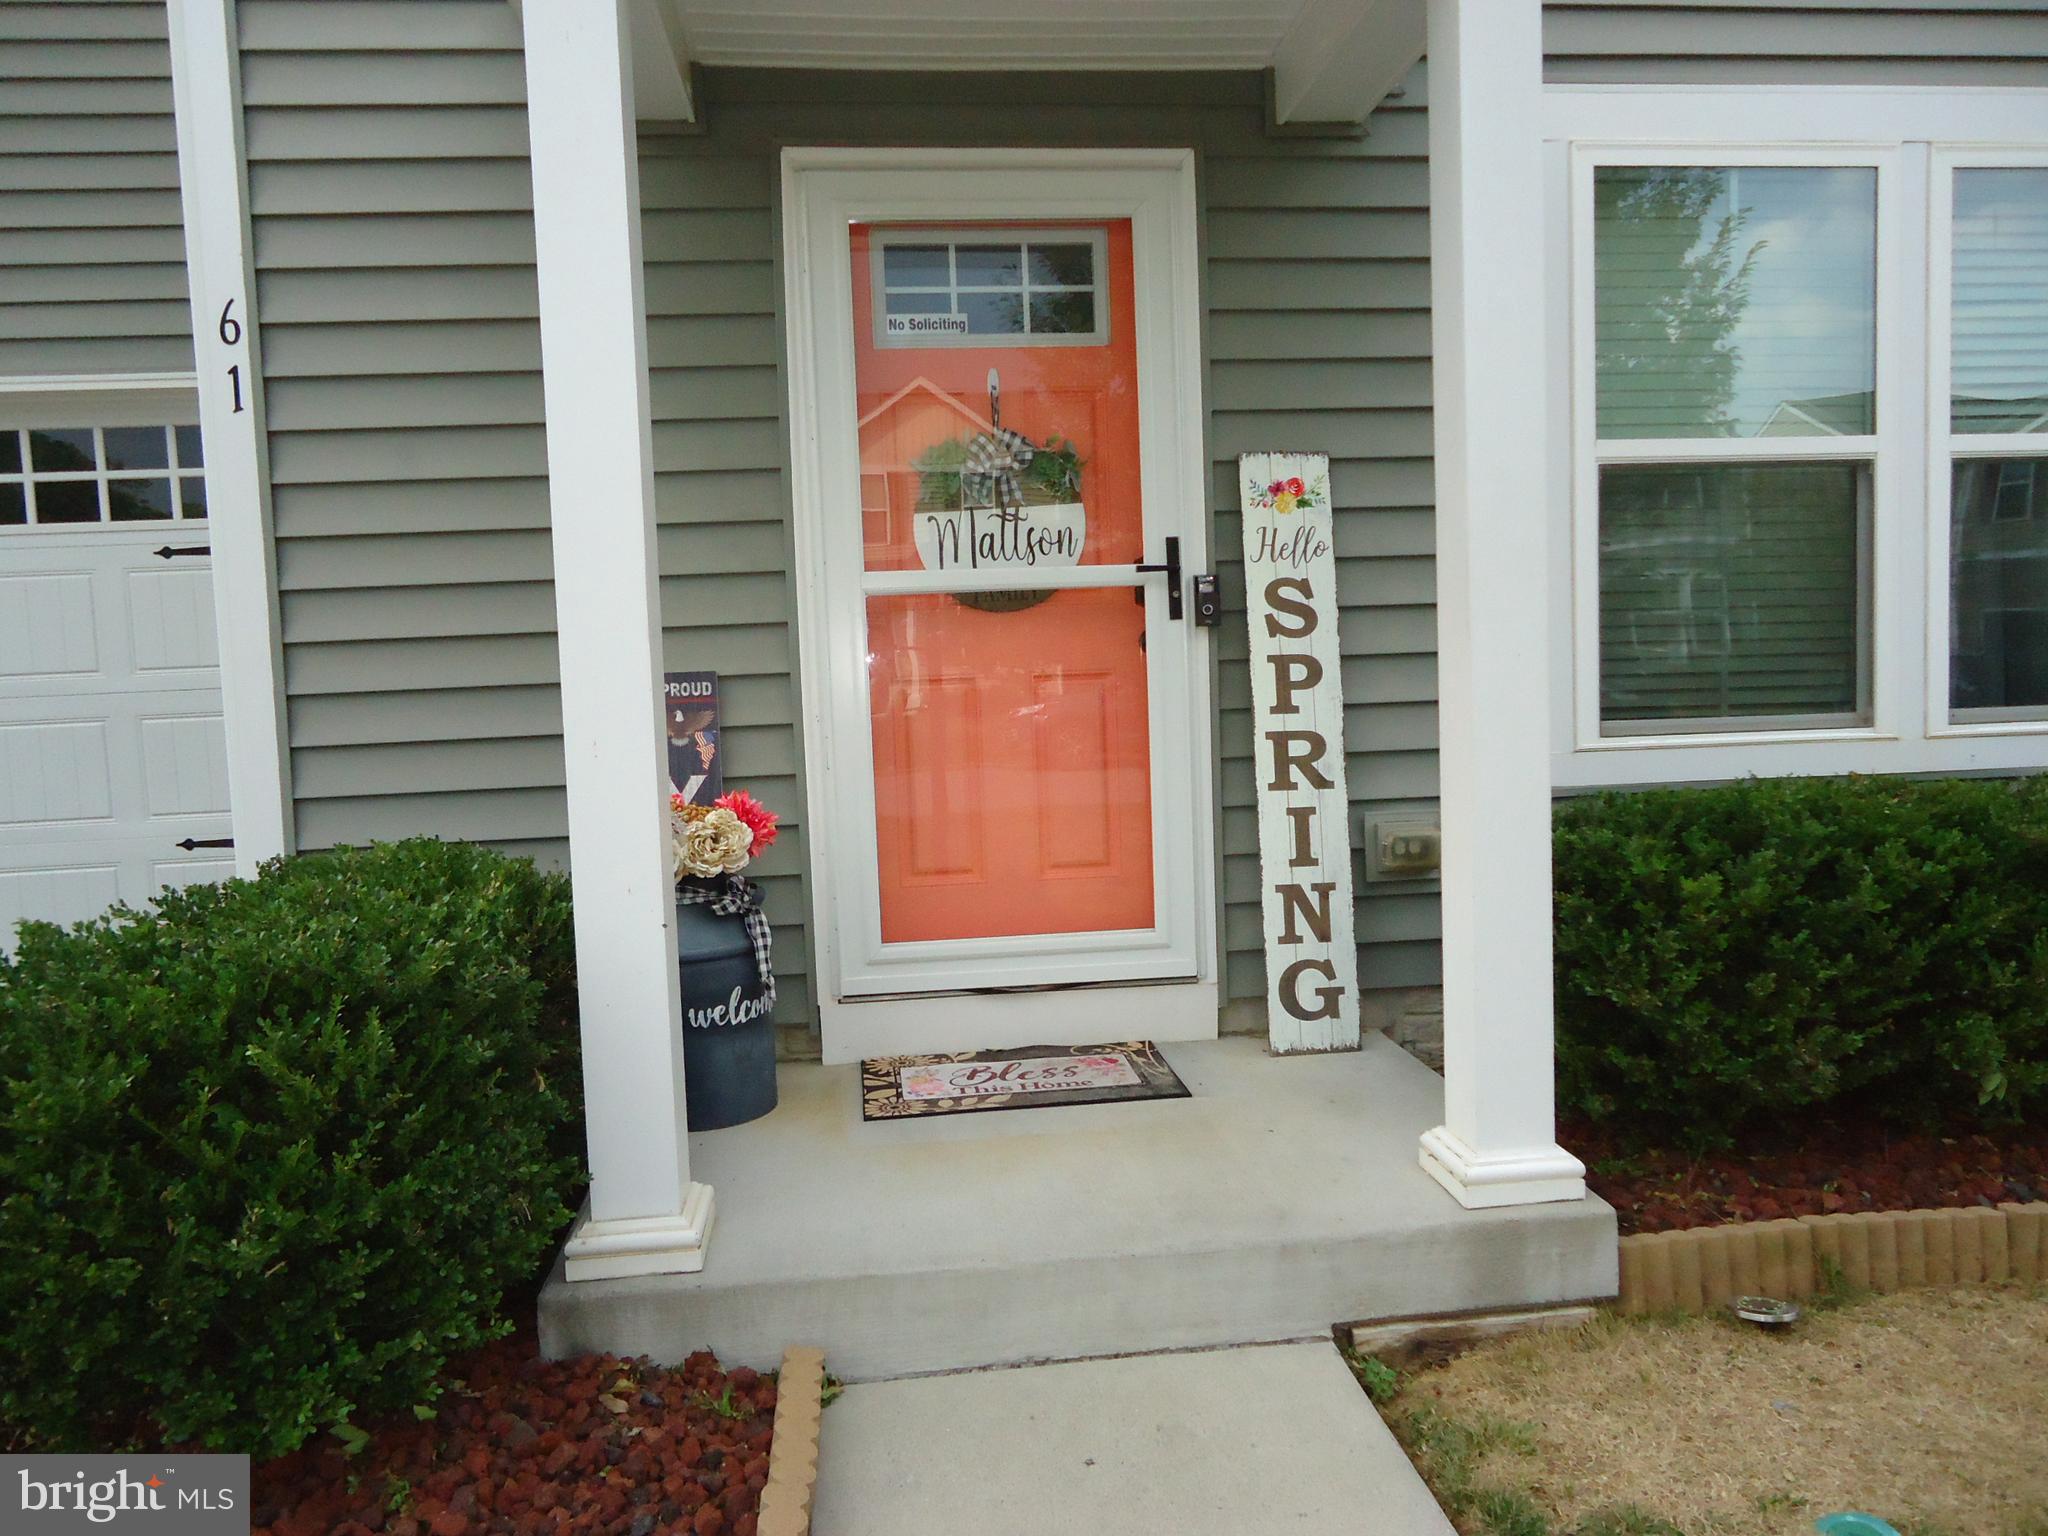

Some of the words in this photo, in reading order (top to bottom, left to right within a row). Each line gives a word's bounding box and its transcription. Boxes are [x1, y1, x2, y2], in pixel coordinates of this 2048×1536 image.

[888, 318, 905, 331] No
[909, 318, 967, 332] Soliciting
[219, 298, 244, 413] 61
[927, 506, 1079, 570] Mattson
[1250, 525, 1330, 569] Hello
[664, 681, 712, 697] PROUD
[1264, 577, 1346, 1022] SPRING
[688, 985, 774, 1029] welcom
[949, 1061, 1079, 1087] Bless
[952, 1082, 1013, 1094] This
[1020, 1080, 1094, 1091] Home
